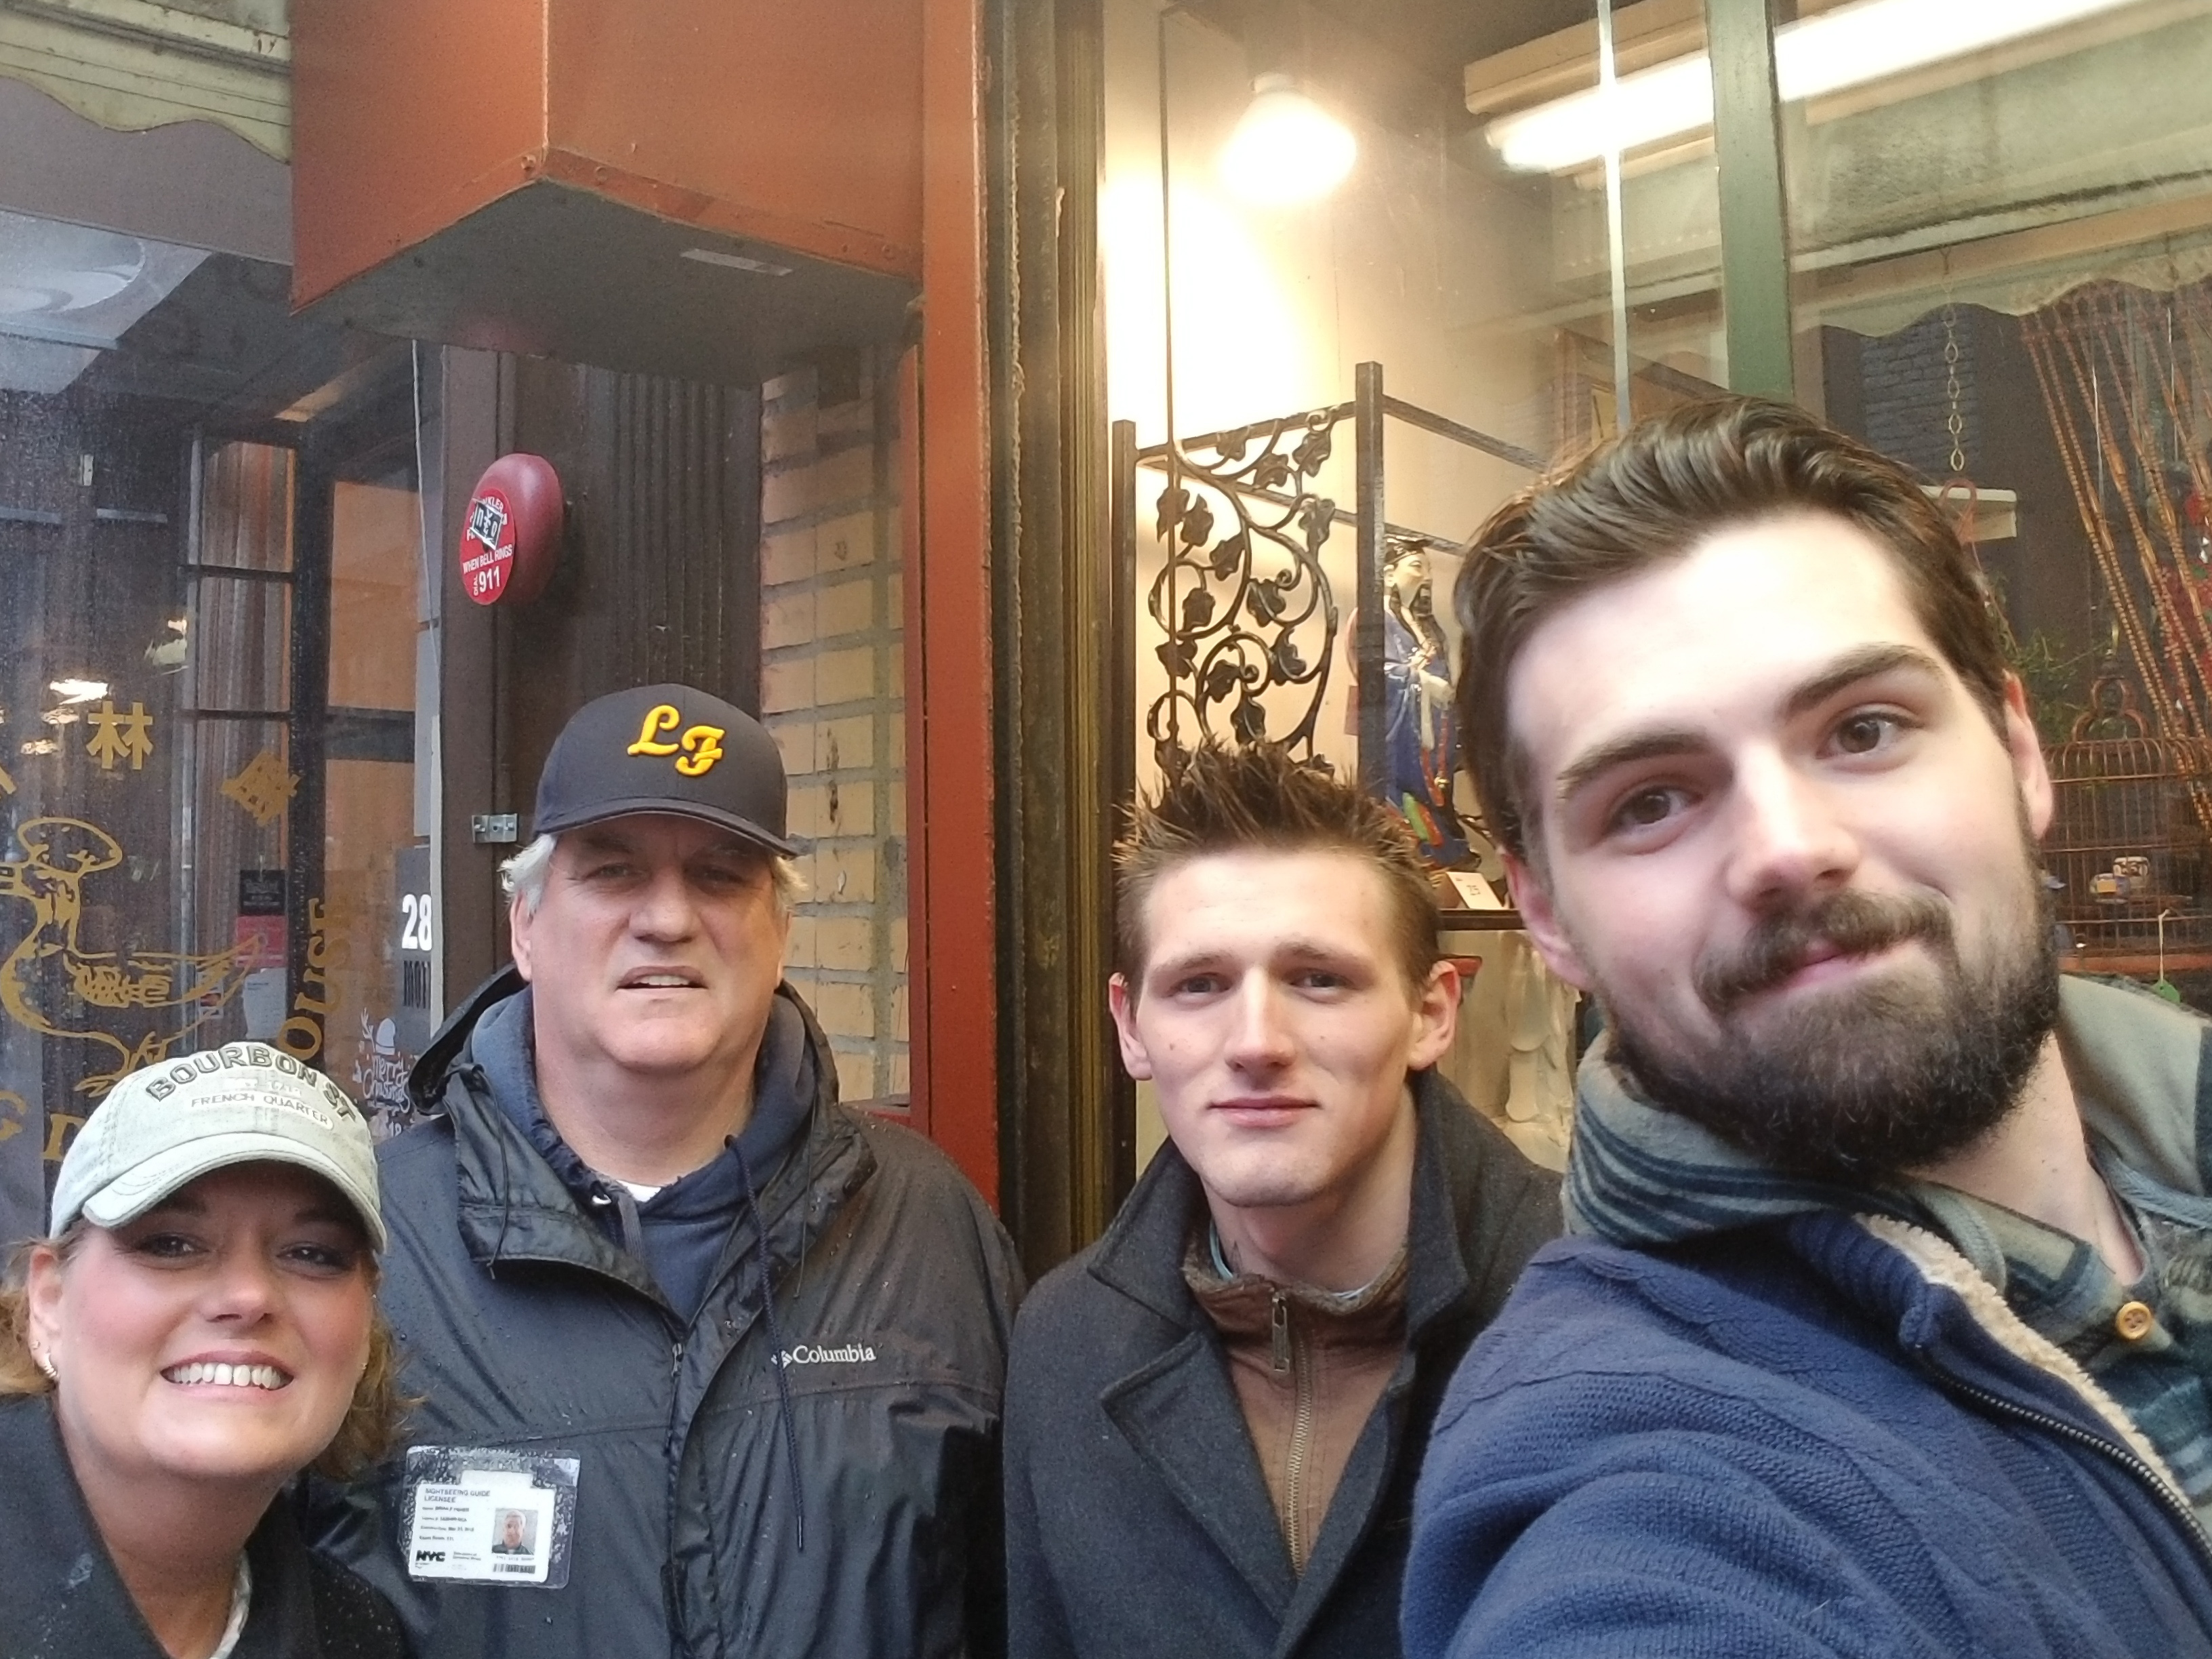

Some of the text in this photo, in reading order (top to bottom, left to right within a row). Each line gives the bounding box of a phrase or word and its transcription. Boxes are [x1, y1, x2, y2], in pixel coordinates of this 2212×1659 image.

[462, 544, 513, 575] WHEN BELL RINGS
[479, 565, 500, 593] 911
[85, 700, 154, 771] 林
[402, 894, 432, 951] 28
[278, 897, 352, 1061] OUSE
[146, 1045, 356, 1122] BOURBON ST
[191, 1093, 329, 1125] FRENCH QUARTER
[792, 1343, 877, 1364] Columbia
[424, 1495, 457, 1503] LICENSEE
[415, 1549, 446, 1562] NYC
